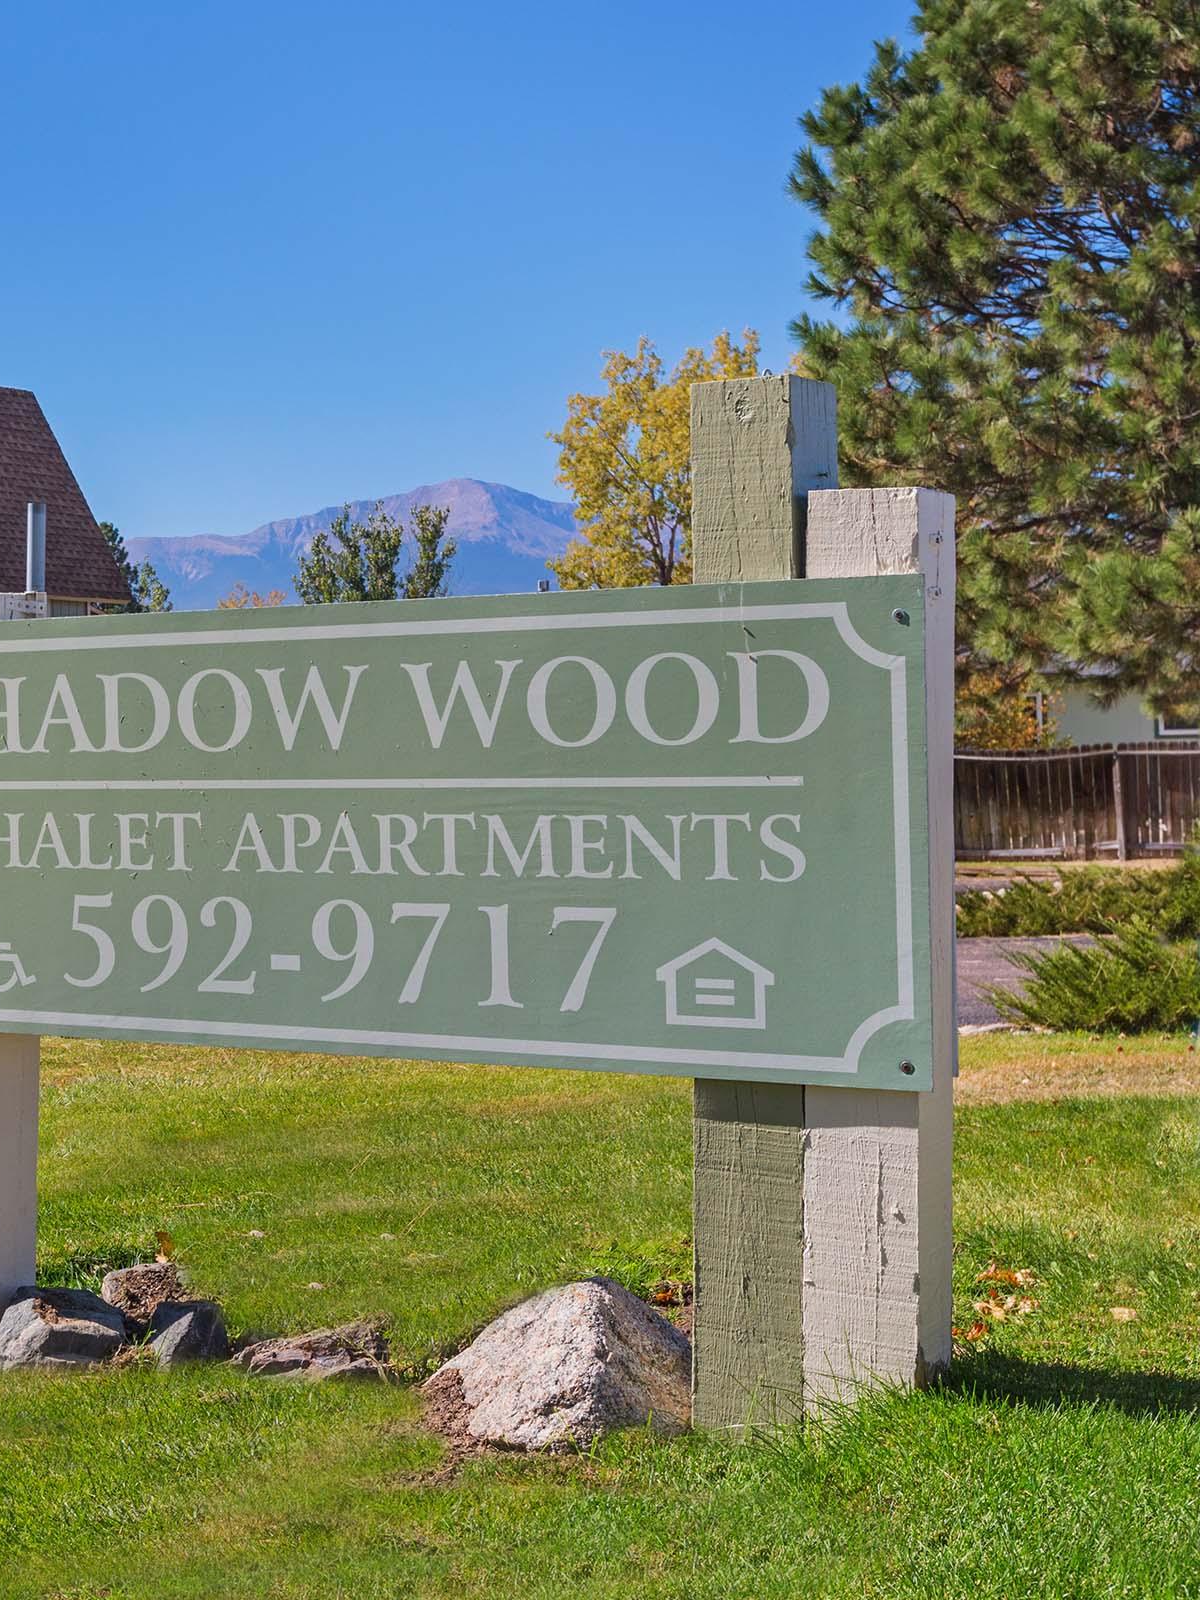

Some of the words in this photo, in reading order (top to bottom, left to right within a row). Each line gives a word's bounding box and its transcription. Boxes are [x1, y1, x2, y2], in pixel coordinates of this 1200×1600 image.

[400, 649, 831, 749] WOOD
[222, 810, 807, 883] APARTMENTS
[63, 891, 617, 1012] 592-9717
